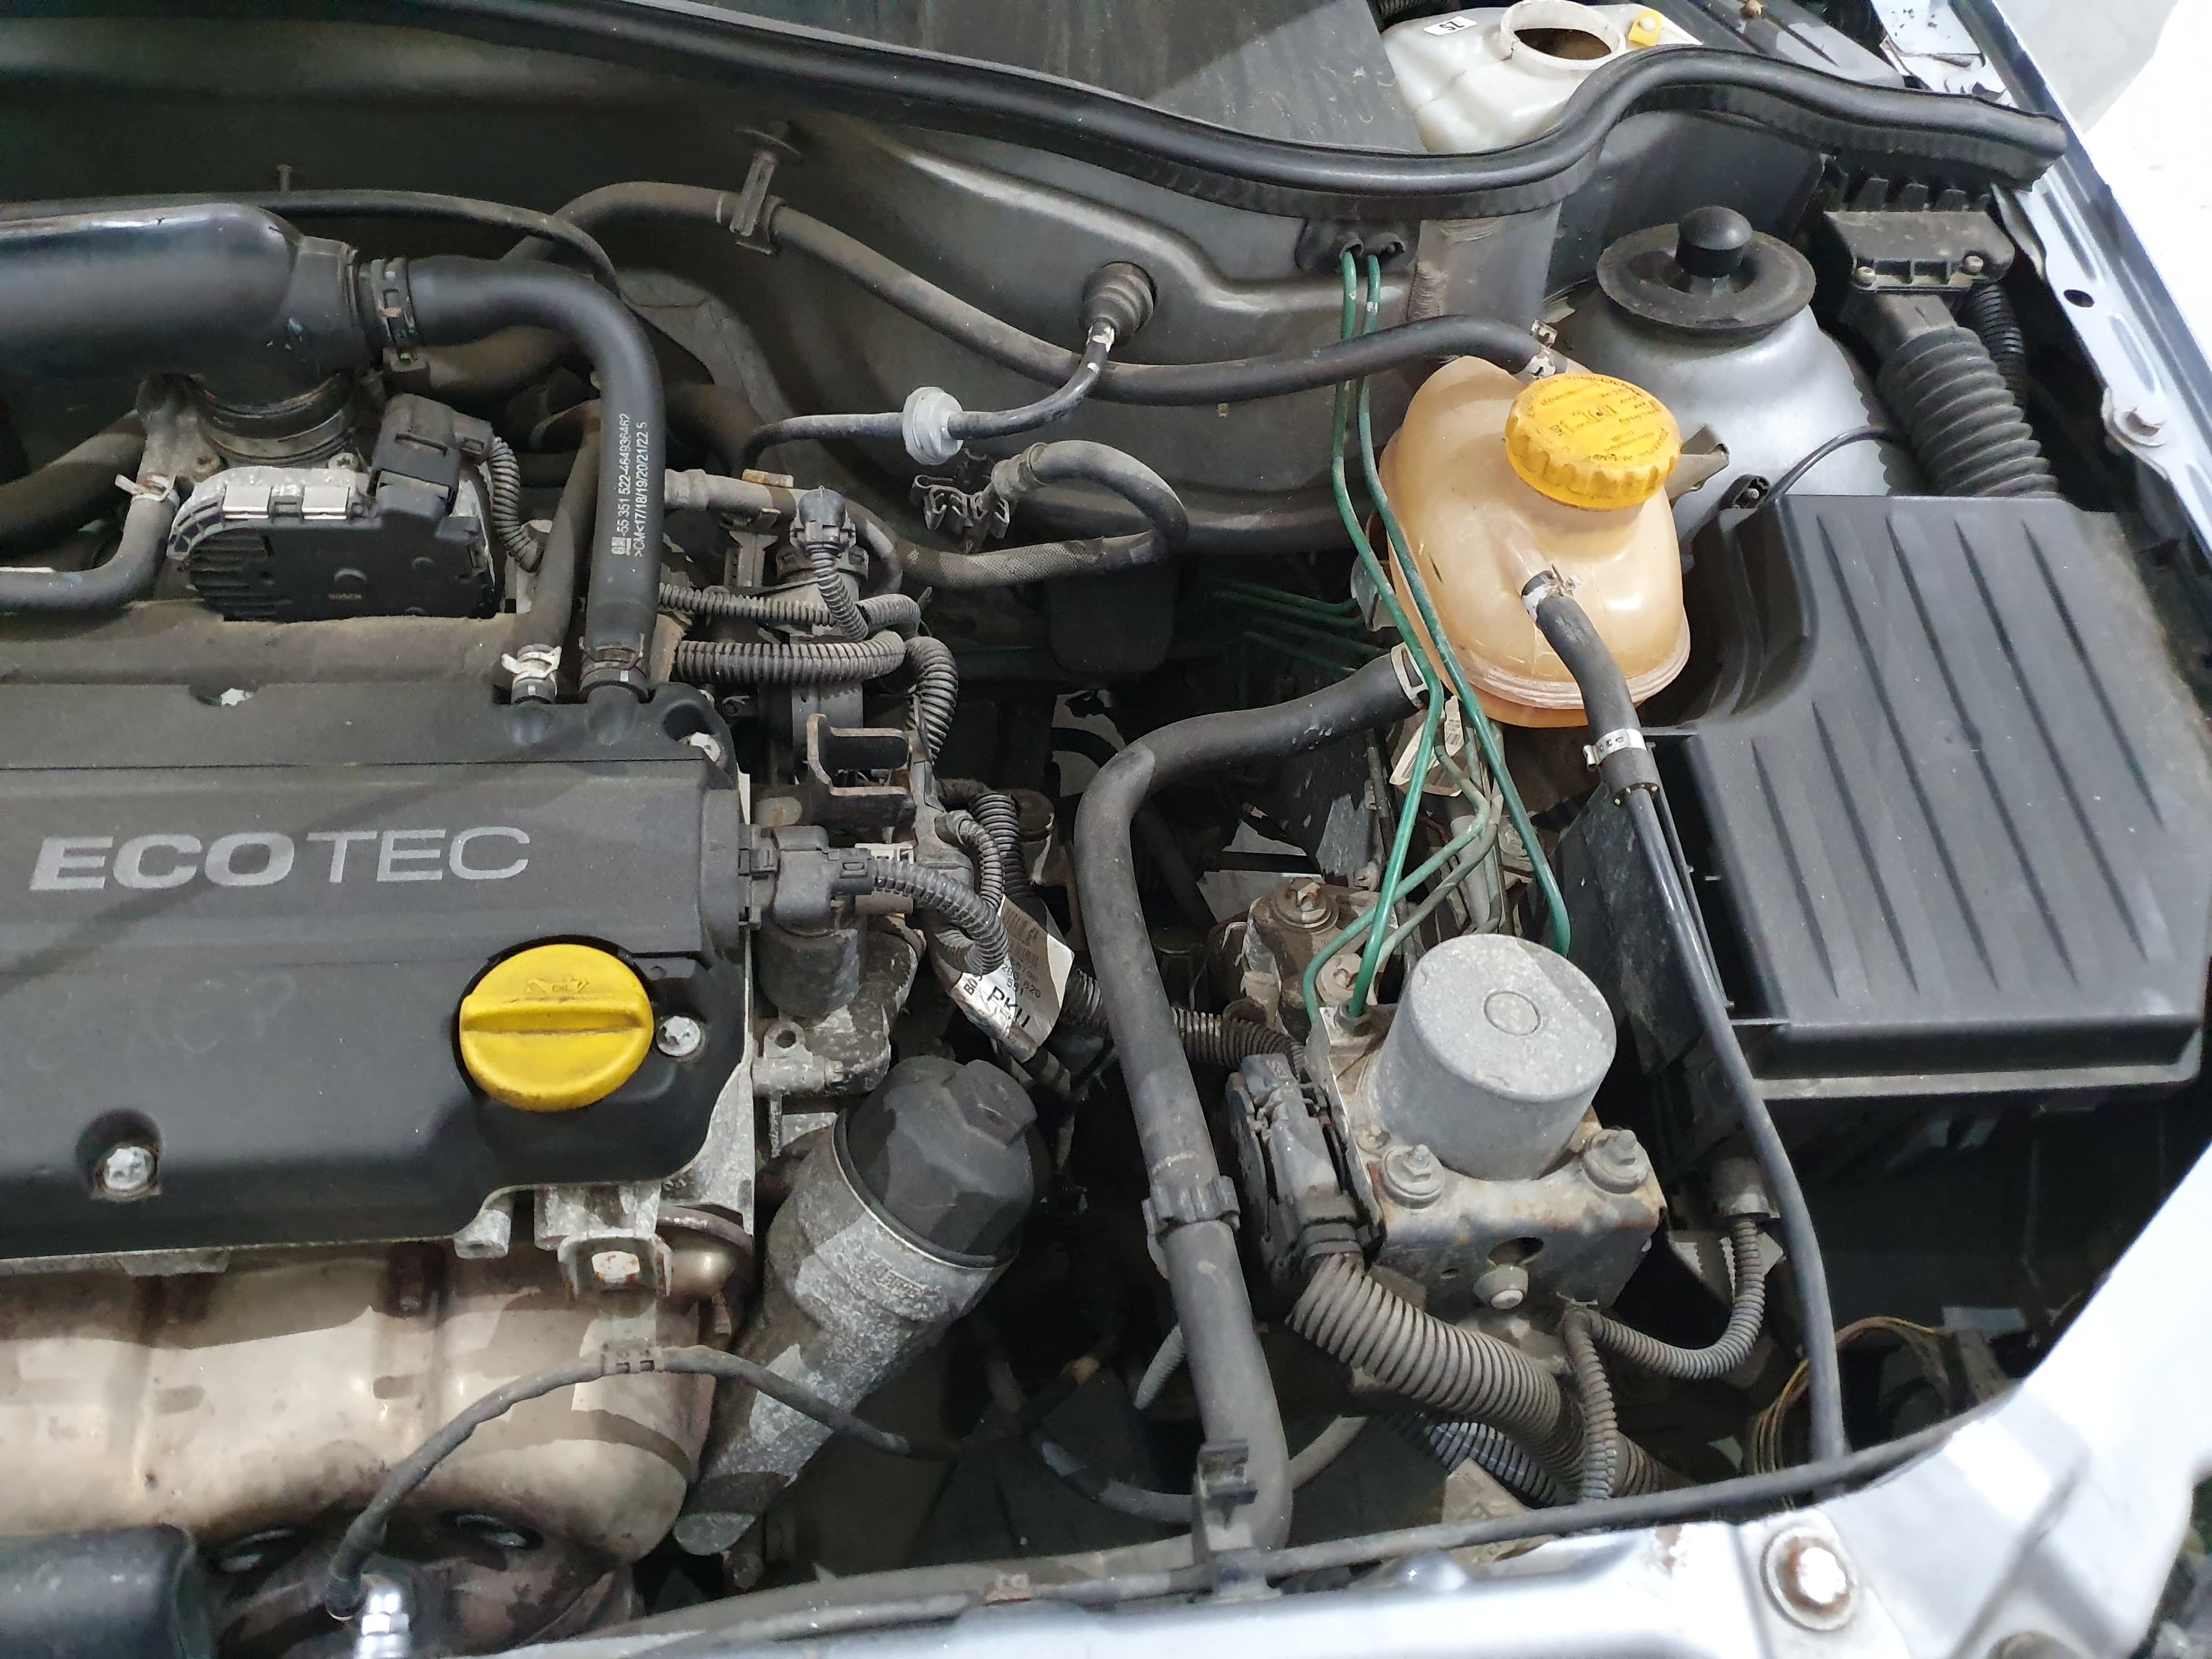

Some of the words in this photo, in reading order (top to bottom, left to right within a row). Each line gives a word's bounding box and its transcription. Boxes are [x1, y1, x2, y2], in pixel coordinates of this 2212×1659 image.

[637, 422, 647, 430] 5
[618, 498, 630, 517] 351
[29, 826, 531, 891] ECOTEC
[552, 983, 572, 992] OIL
